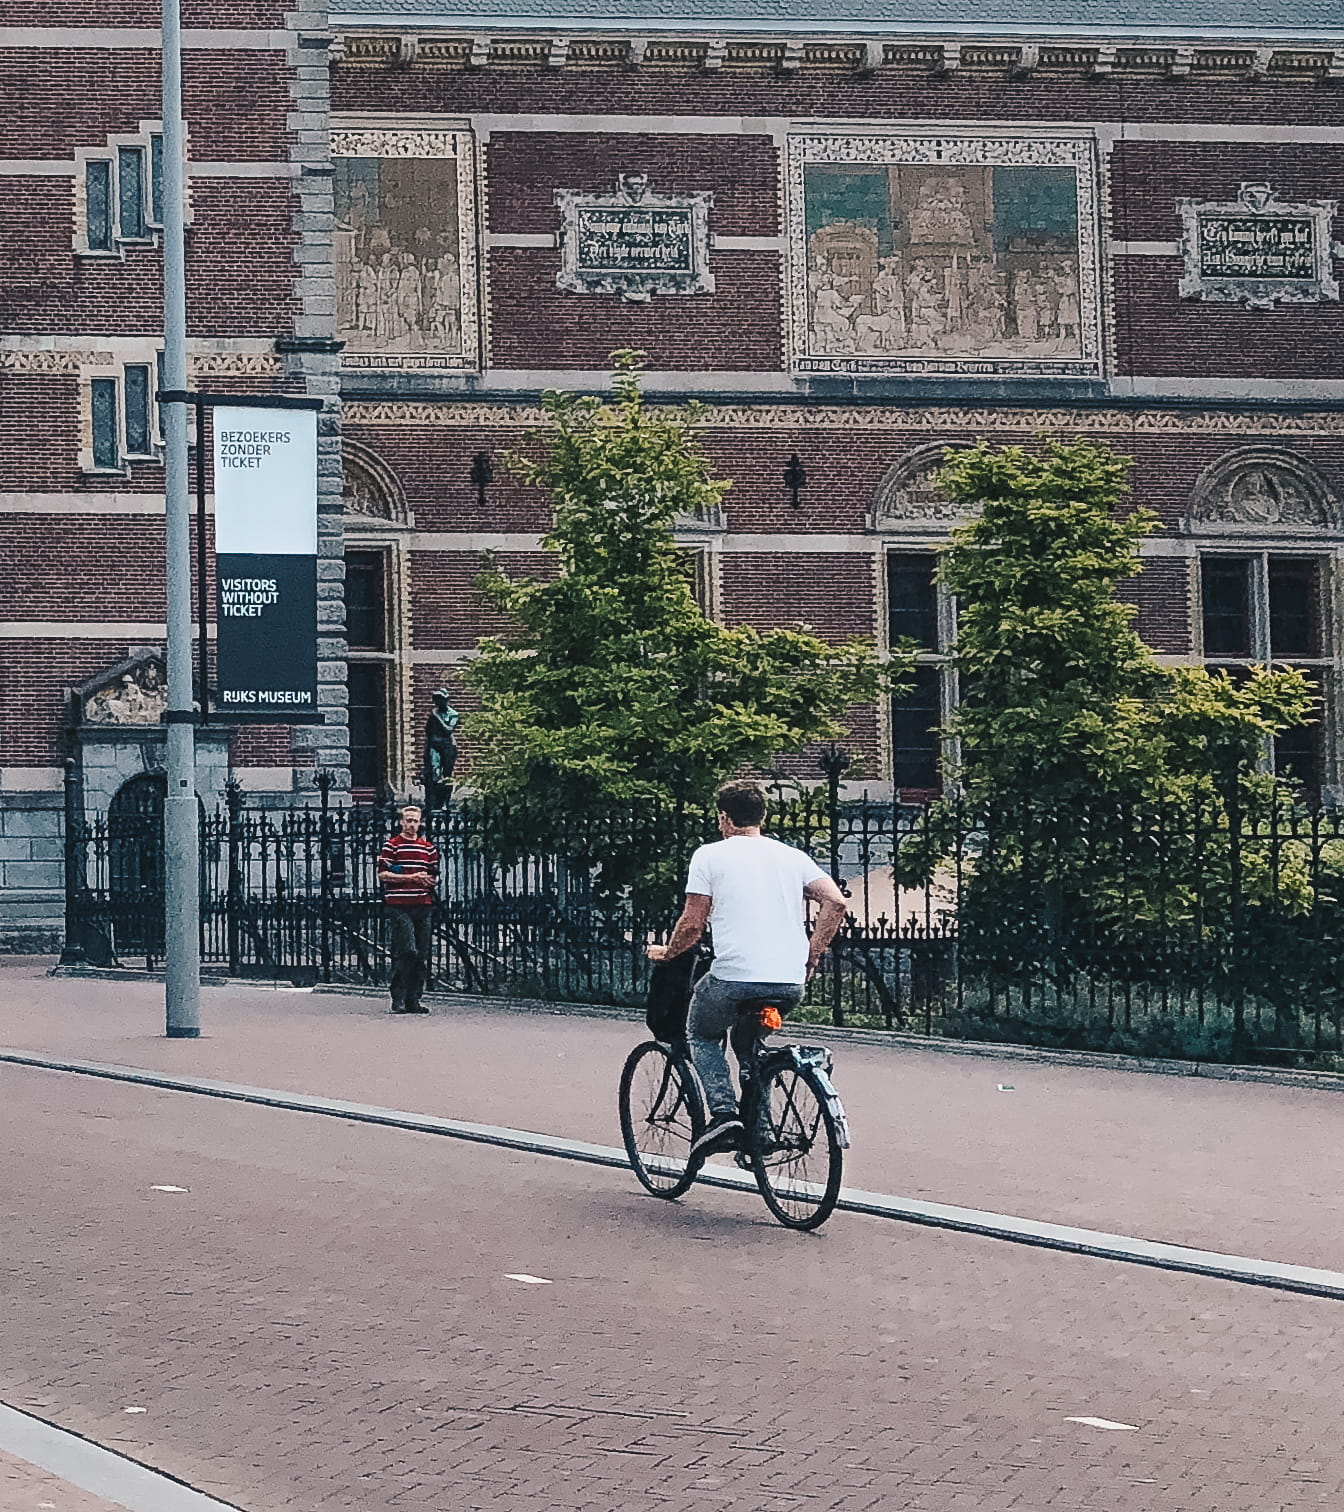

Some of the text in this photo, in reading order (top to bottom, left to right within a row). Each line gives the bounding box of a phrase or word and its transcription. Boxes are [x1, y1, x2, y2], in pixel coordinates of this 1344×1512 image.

[221, 431, 291, 443] BEZOEKERS
[221, 444, 271, 455] ZONDER
[221, 456, 262, 468] TICKET
[222, 578, 277, 591] VISITORS
[222, 591, 279, 604] WITHOUT
[222, 604, 263, 616] TICKET
[223, 690, 311, 704] RIJKS MUSEUM
